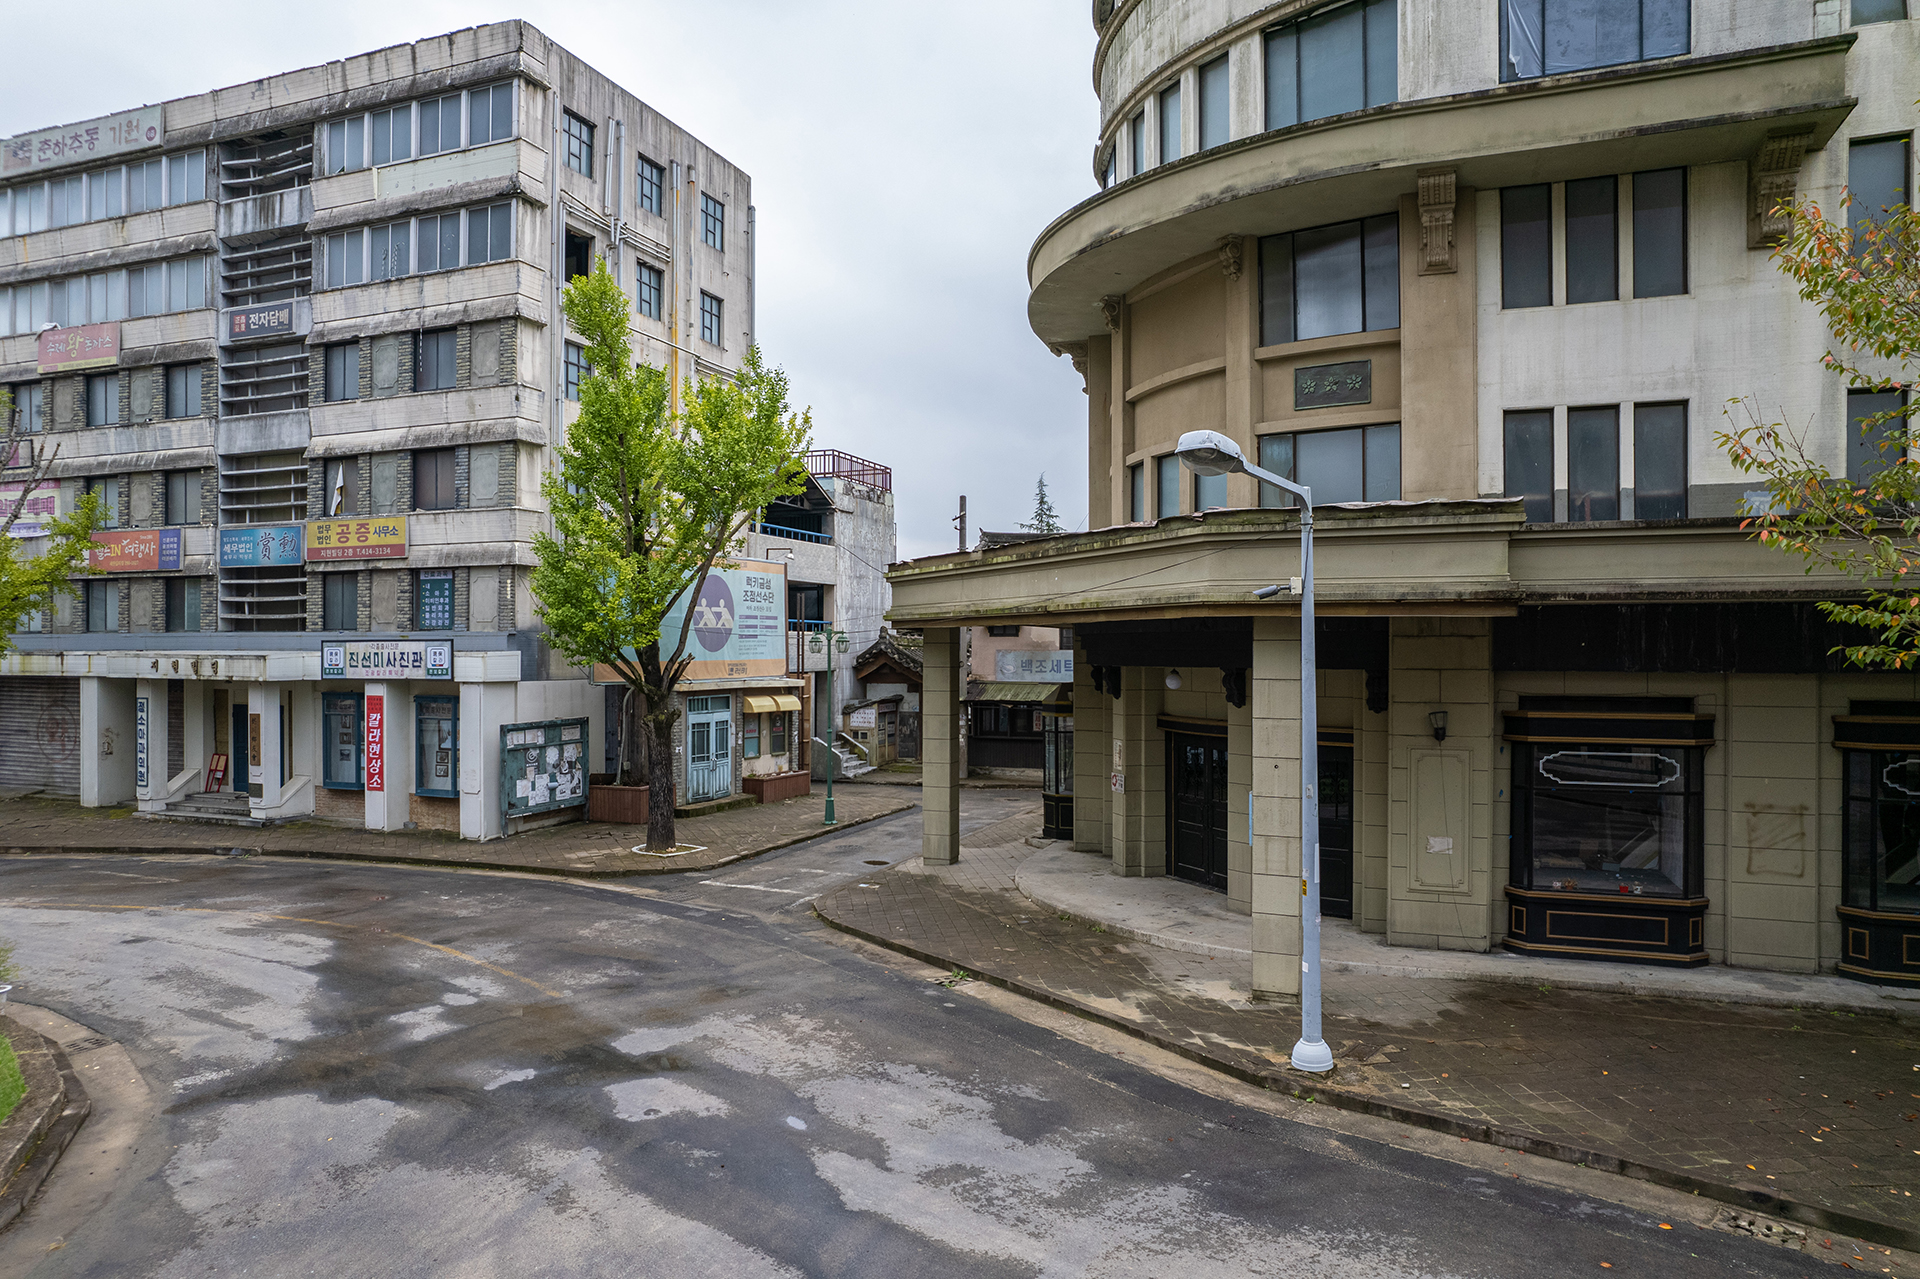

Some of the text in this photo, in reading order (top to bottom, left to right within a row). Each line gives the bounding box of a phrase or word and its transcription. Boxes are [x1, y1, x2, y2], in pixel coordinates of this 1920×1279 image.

[37, 118, 140, 163] 춘하추동 기원
[249, 308, 289, 329] 전자담배
[316, 524, 332, 535] 법무
[336, 522, 399, 544] 공증 사무소
[223, 543, 253, 553] 세무법인
[316, 535, 332, 545] 법인
[124, 540, 156, 558] 여행사
[356, 547, 391, 556] T.414-3134
[746, 575, 772, 590] 럭키금성
[743, 590, 775, 604] 조정선수단
[348, 651, 424, 669] 진선미사진관
[368, 712, 382, 788] 칼라현상소
